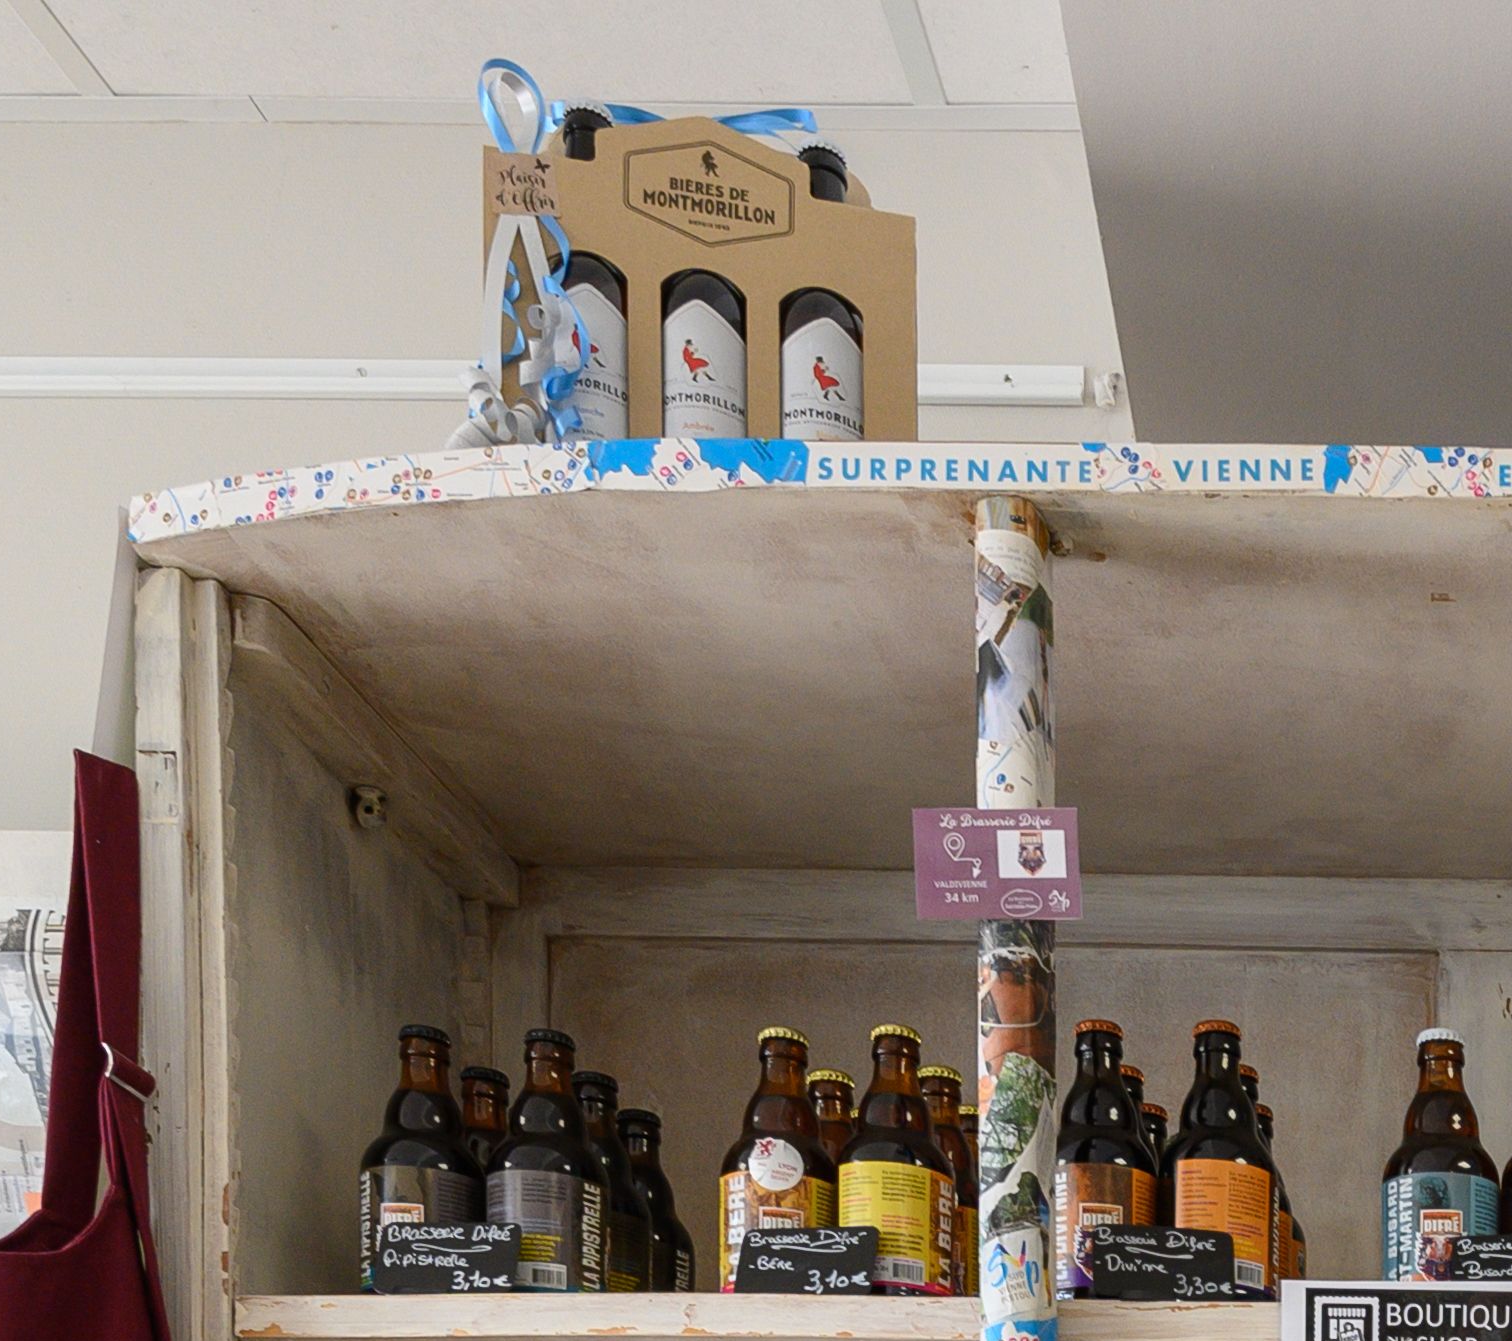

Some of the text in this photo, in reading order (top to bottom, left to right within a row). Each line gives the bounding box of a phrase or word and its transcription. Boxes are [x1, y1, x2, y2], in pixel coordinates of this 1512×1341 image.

[496, 165, 548, 191] Plaisir
[729, 186, 750, 202] DE
[643, 188, 775, 225] MONTMORILLON
[817, 457, 1092, 484] SURPRENANTE
[1173, 458, 1314, 483] VIENNE
[940, 813, 1052, 830] La Brasserie Difré
[934, 880, 987, 888] VALDIVIENNE
[944, 892, 979, 903] 34 km
[451, 1270, 512, 1291] 3,10€
[804, 1269, 870, 1295] 3,10€
